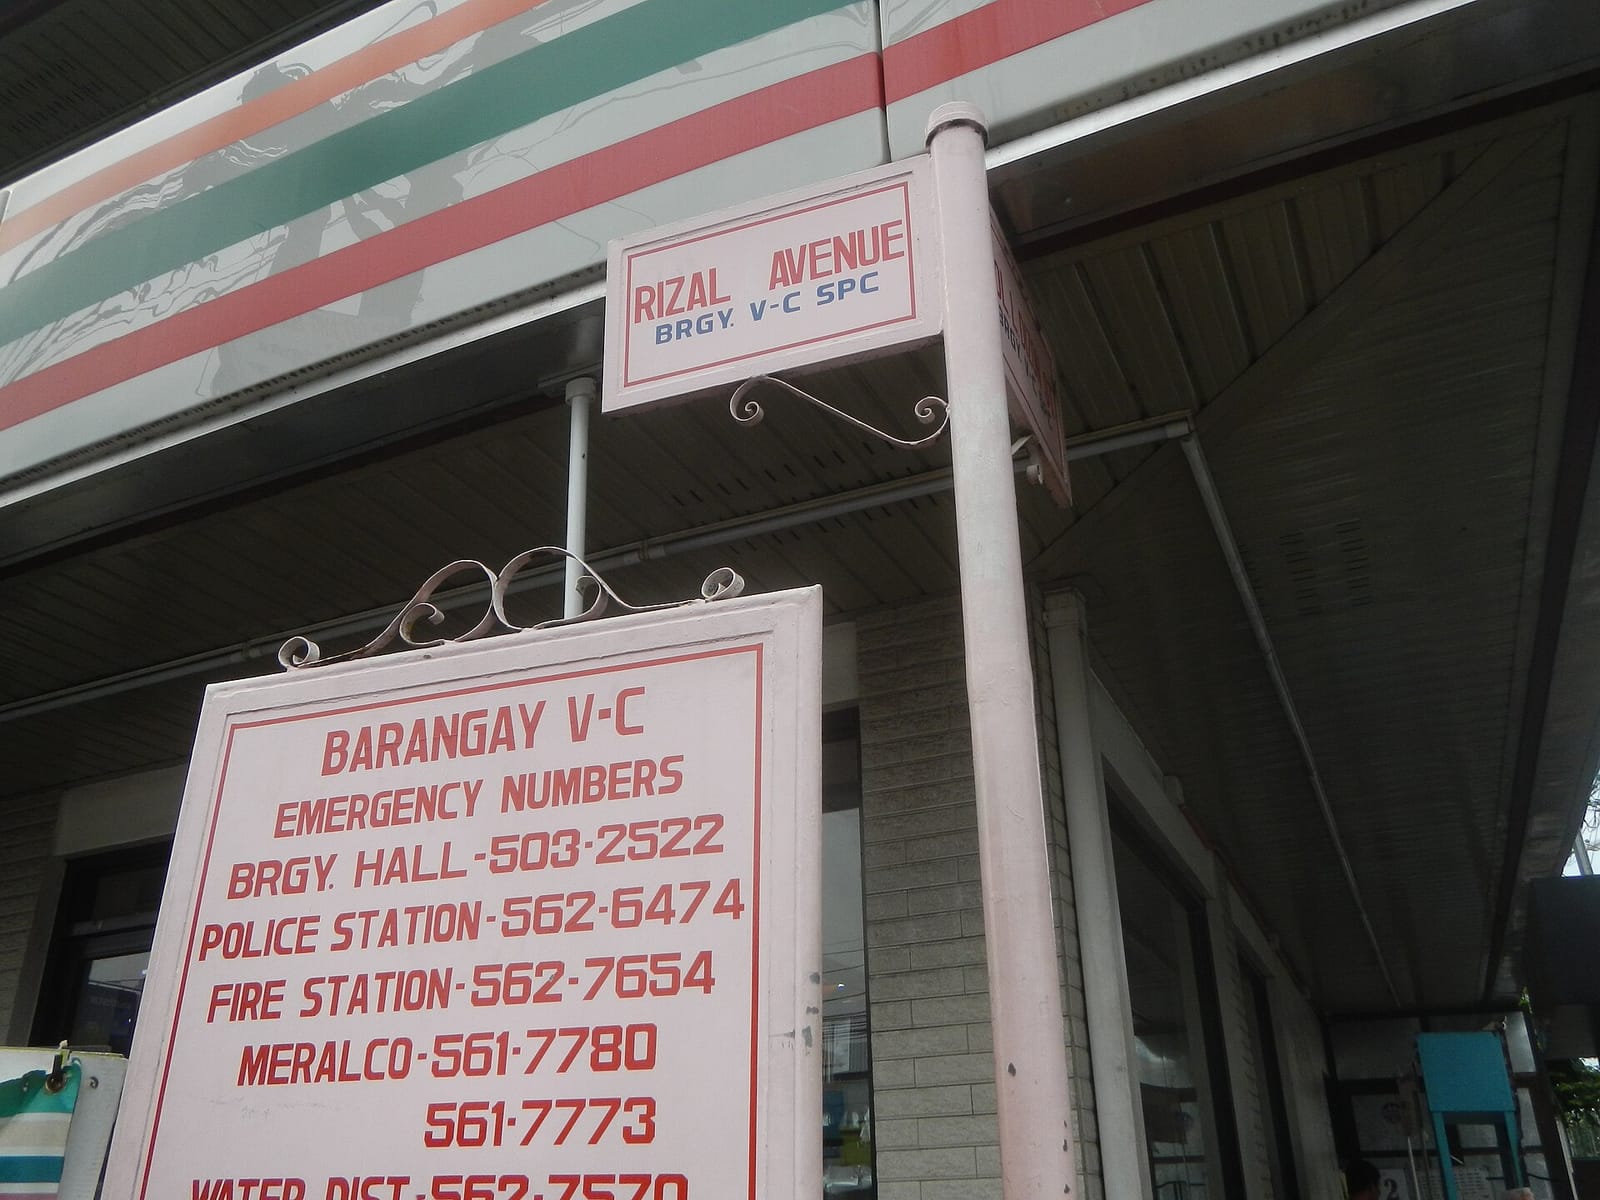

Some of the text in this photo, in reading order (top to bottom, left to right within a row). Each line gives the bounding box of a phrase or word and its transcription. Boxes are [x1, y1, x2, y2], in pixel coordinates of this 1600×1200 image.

[633, 219, 906, 325] RIZAL AVENUE
[654, 271, 880, 346] BRGY. V-C SPC
[321, 685, 646, 777] BARANGAY V-C
[273, 754, 684, 840] EMERGENCY NUMBERS
[226, 854, 337, 901] BRGY.
[198, 914, 322, 963] POLICE
[206, 979, 287, 1025] FIRE
[423, 1096, 657, 1149] 561-7773
